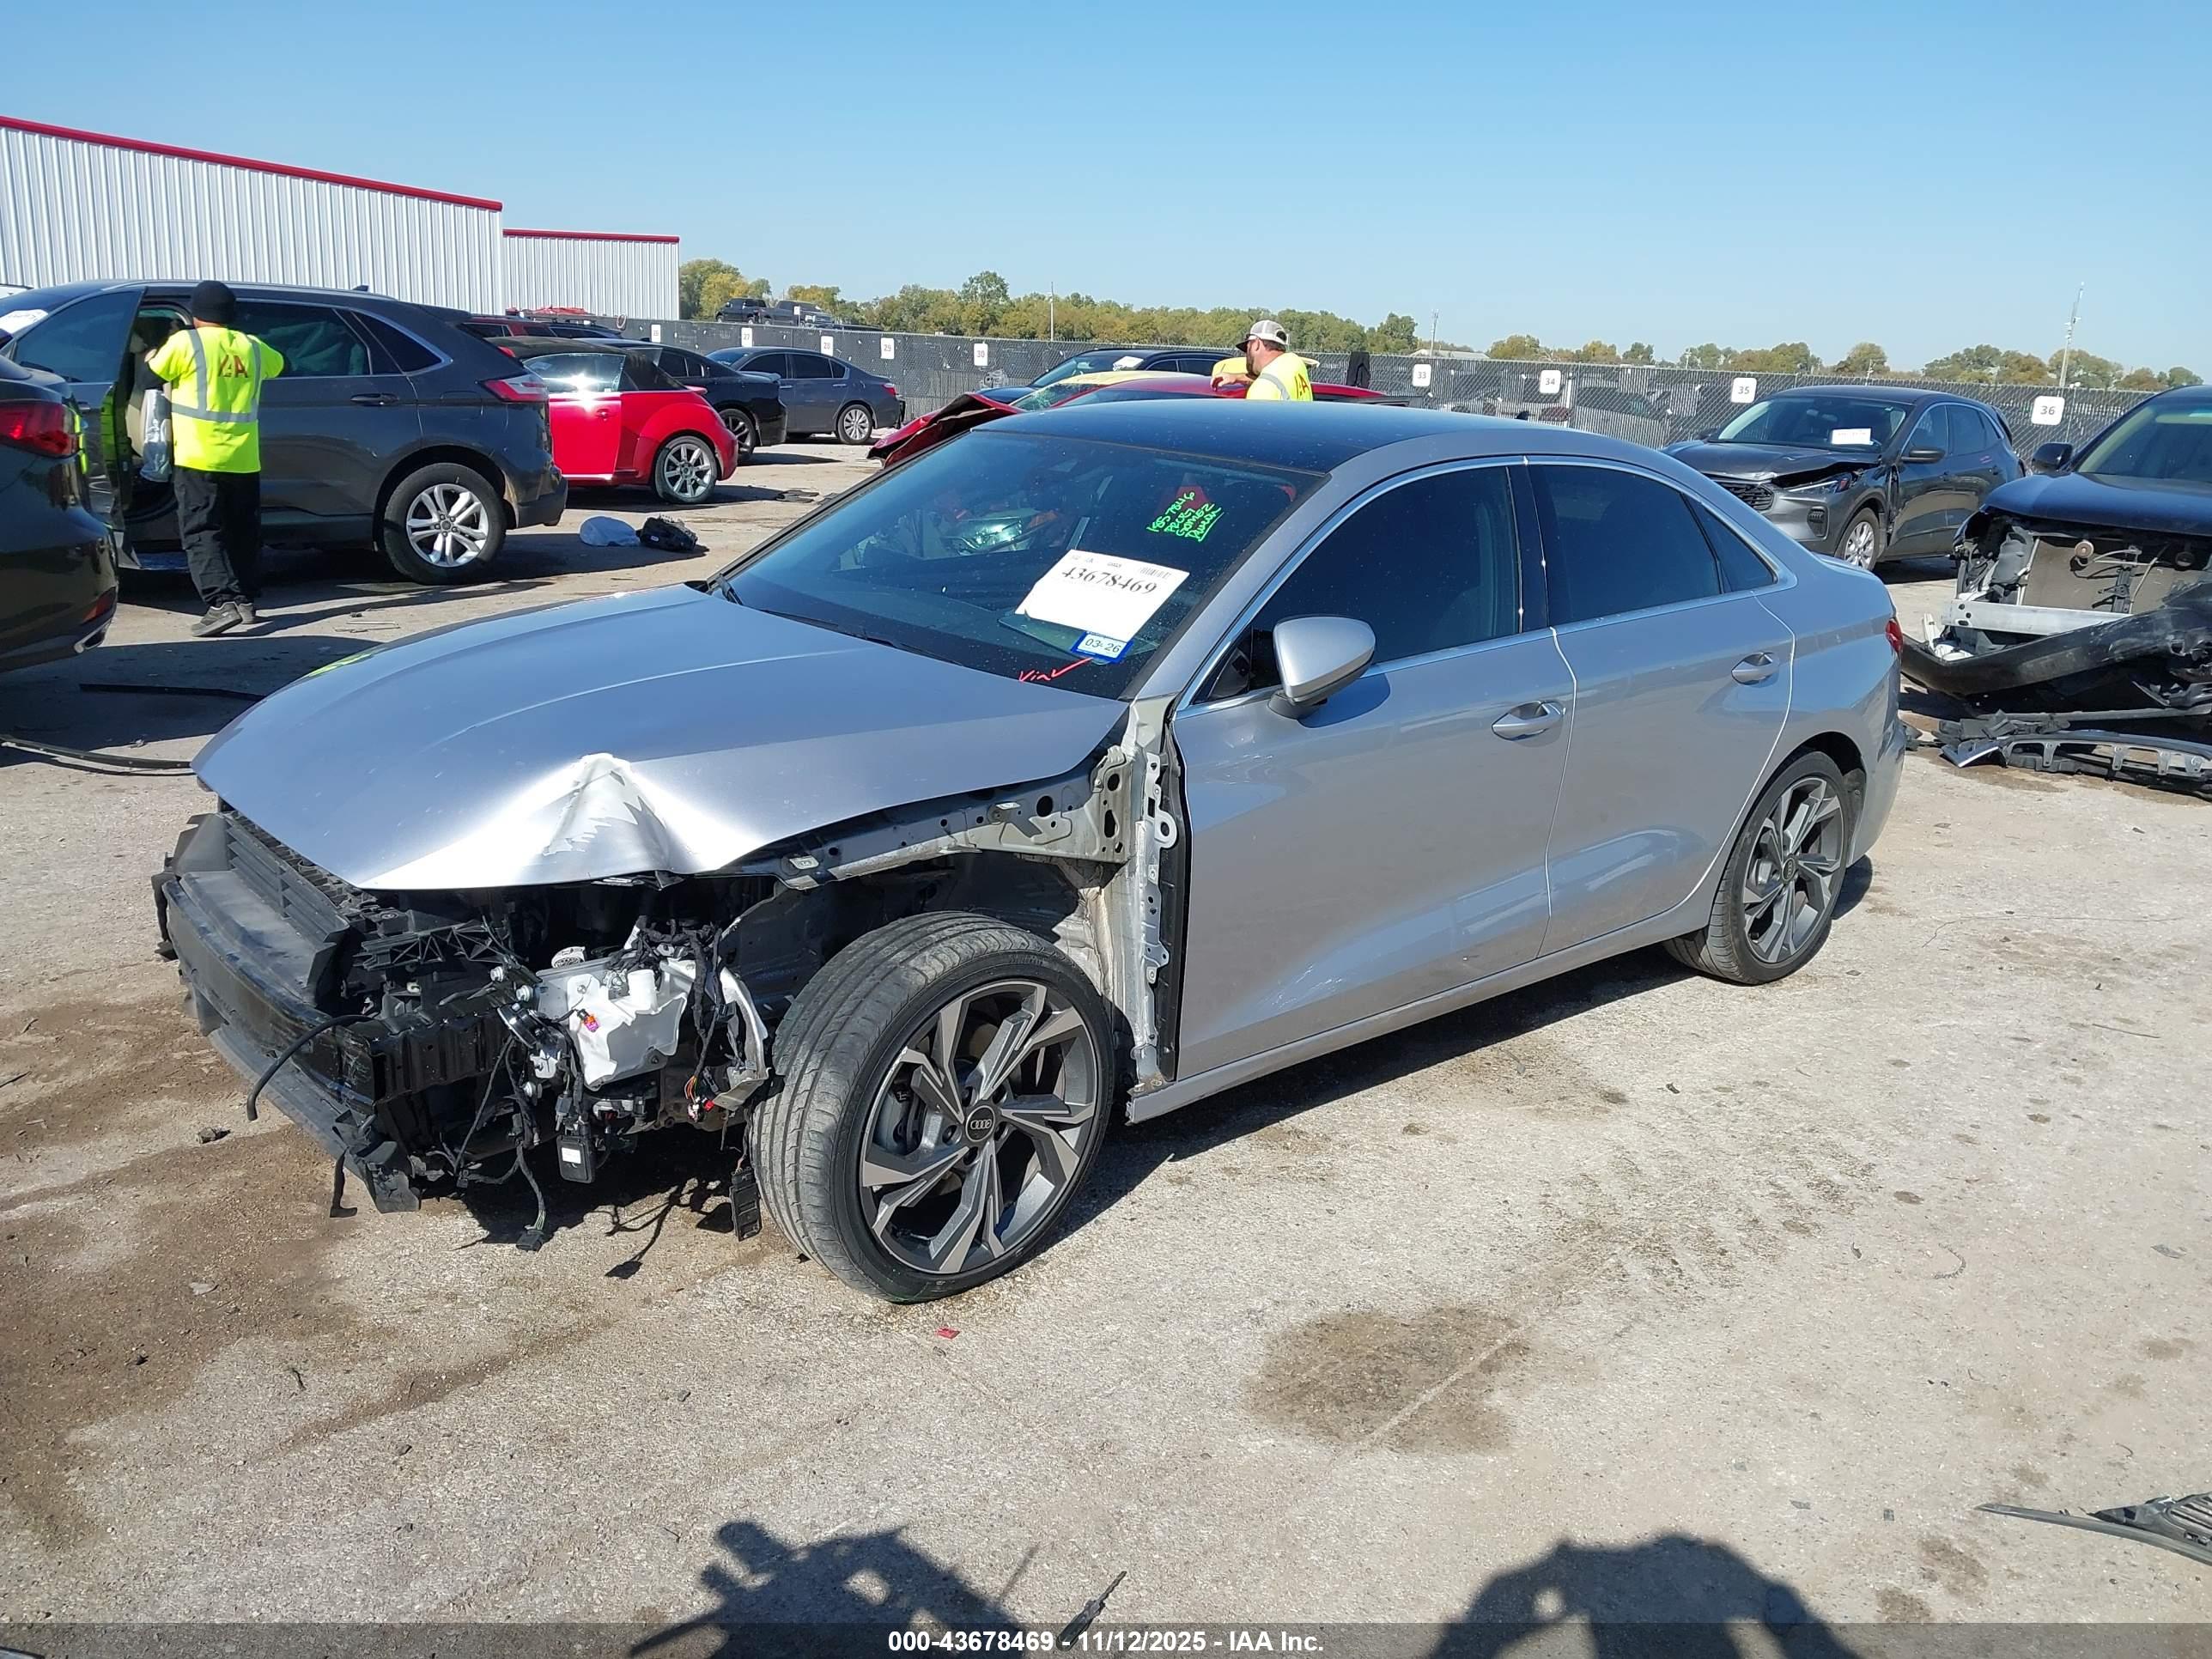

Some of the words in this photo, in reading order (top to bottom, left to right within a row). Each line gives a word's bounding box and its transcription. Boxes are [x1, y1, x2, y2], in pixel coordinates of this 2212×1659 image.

[884, 343, 892, 352] 29
[976, 349, 986, 358] 30
[1417, 370, 1427, 380] 33
[1545, 377, 1556, 386] 34
[1737, 386, 1750, 395] 35
[2039, 405, 2056, 416] 36
[1062, 566, 1158, 594] 43678469
[1085, 638, 1121, 653] 03-26
